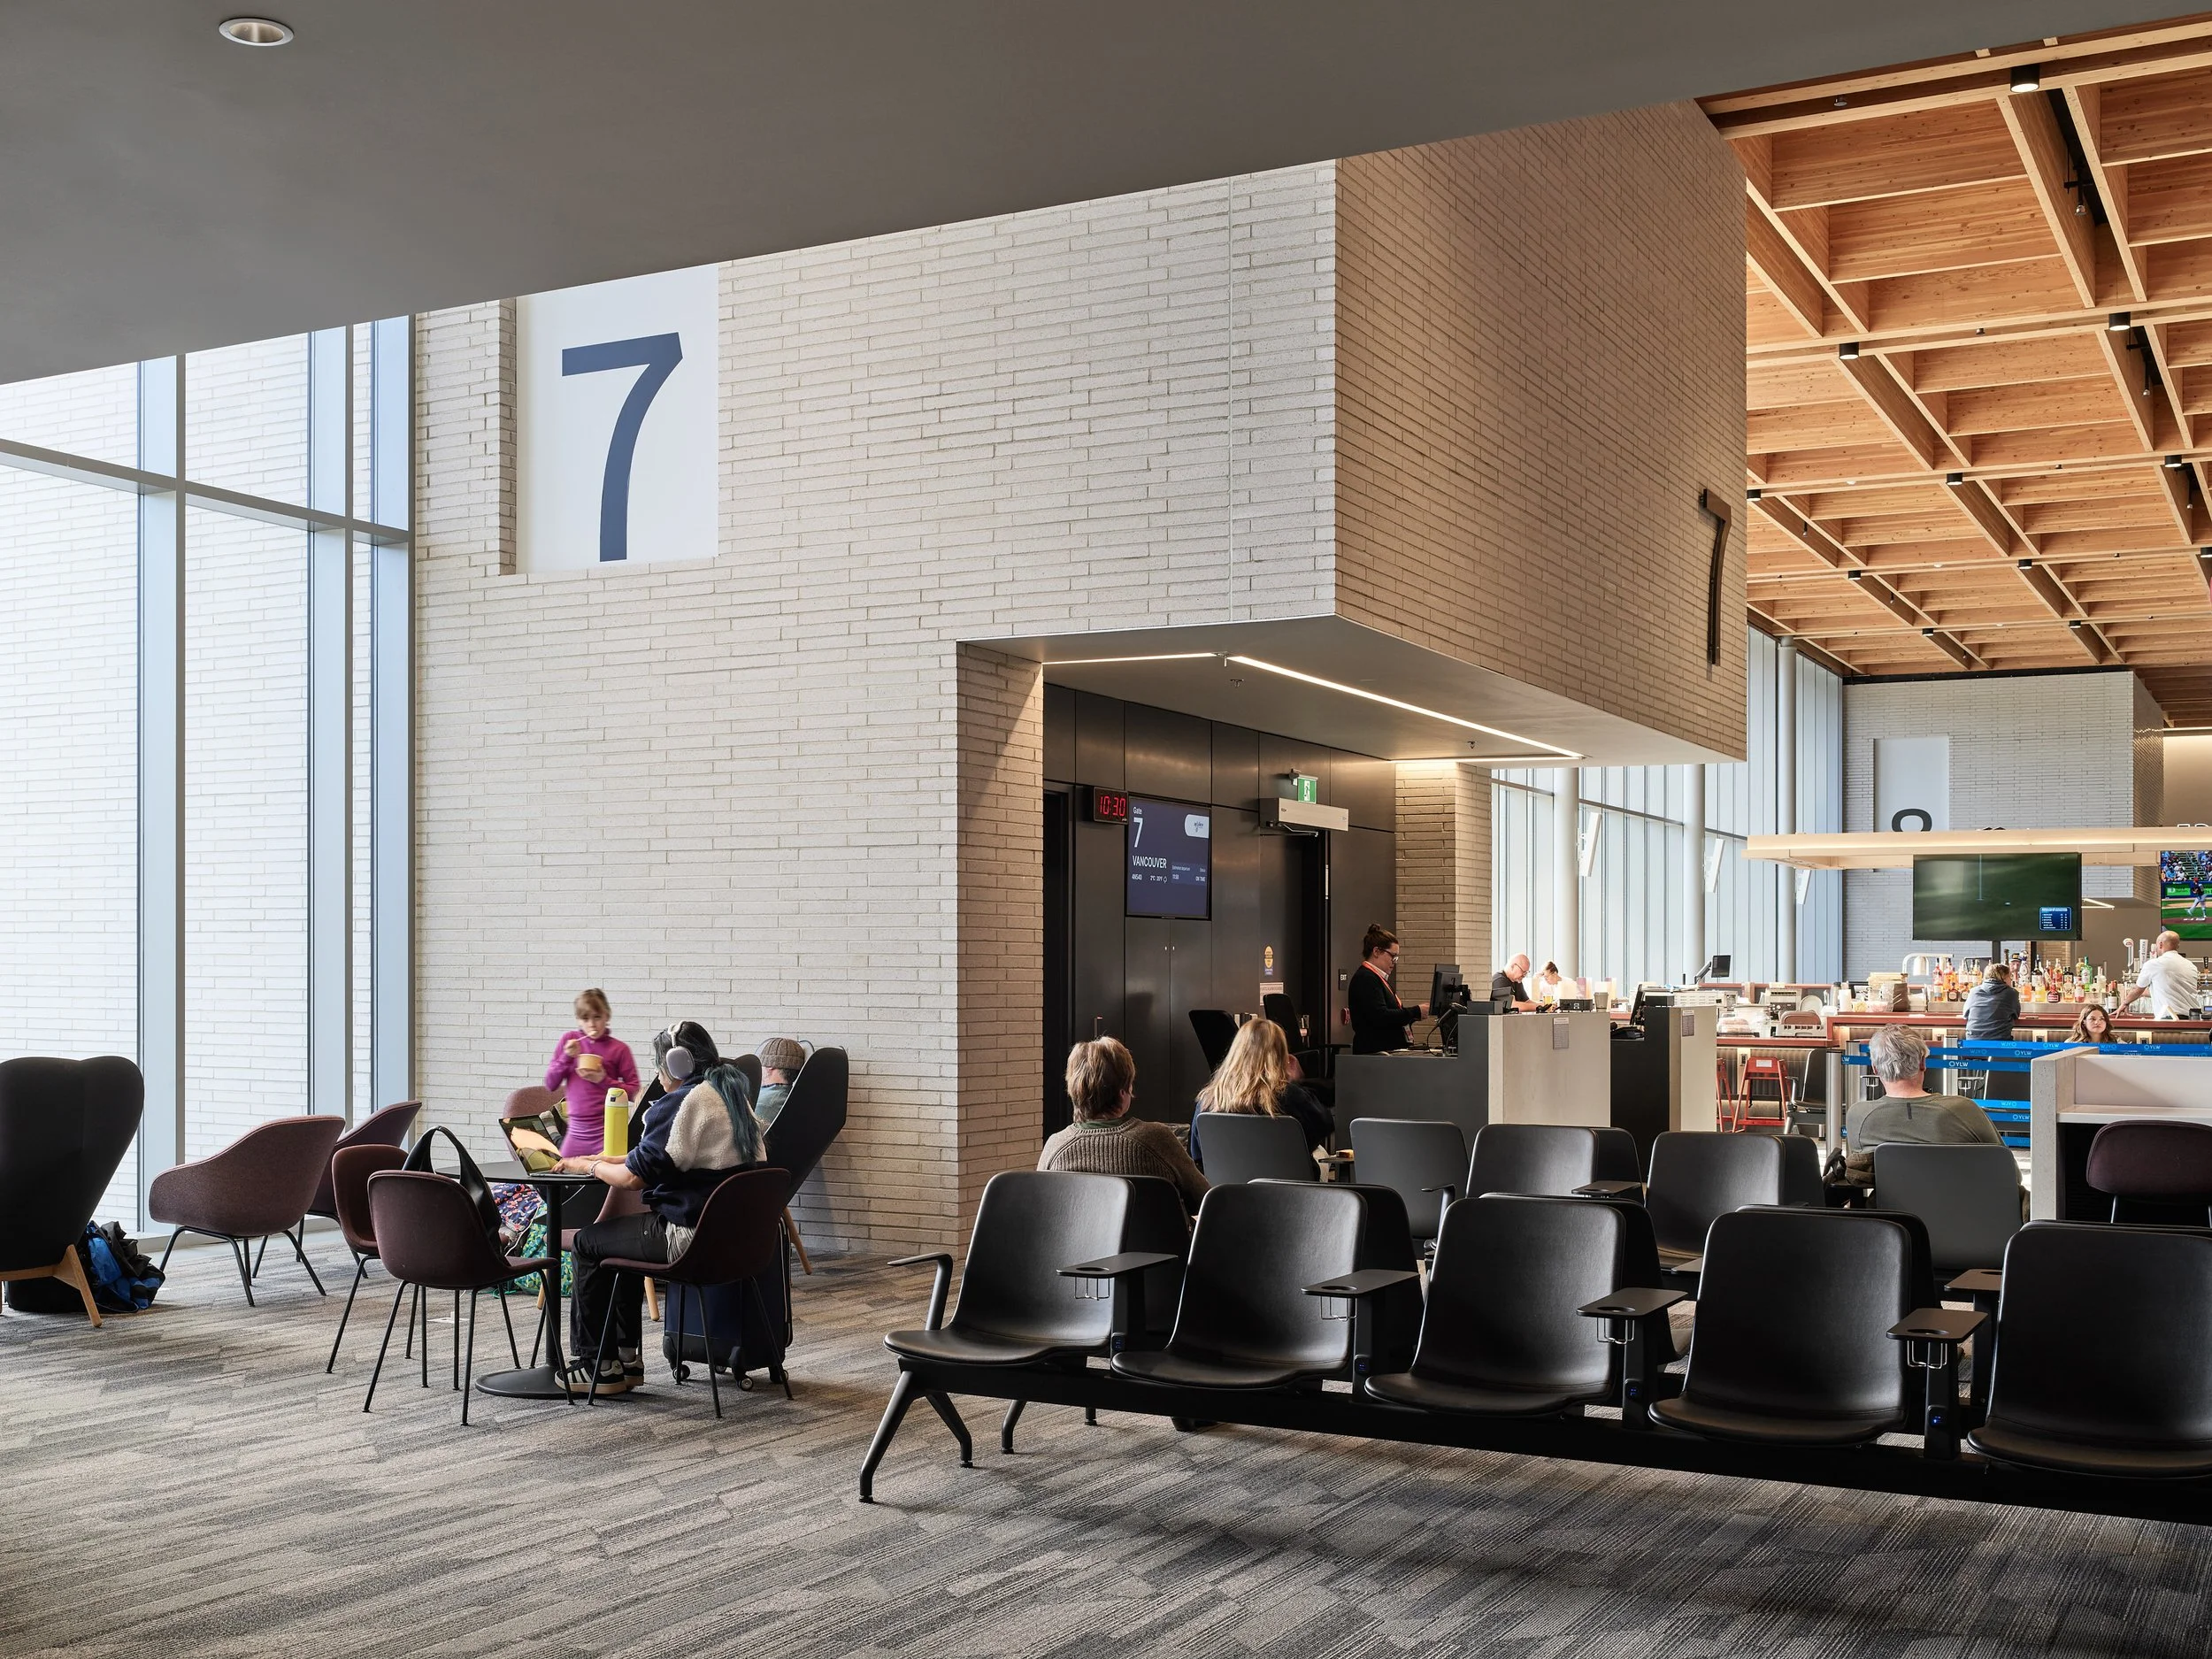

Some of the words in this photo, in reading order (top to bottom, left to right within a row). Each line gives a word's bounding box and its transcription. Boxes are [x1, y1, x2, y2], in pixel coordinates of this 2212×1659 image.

[562, 332, 683, 562] 7
[1702, 488, 1732, 667] 7
[1100, 796, 1126, 817] 10:30
[1133, 817, 1143, 848] 7
[1133, 856, 1167, 869] VANCOUVER
